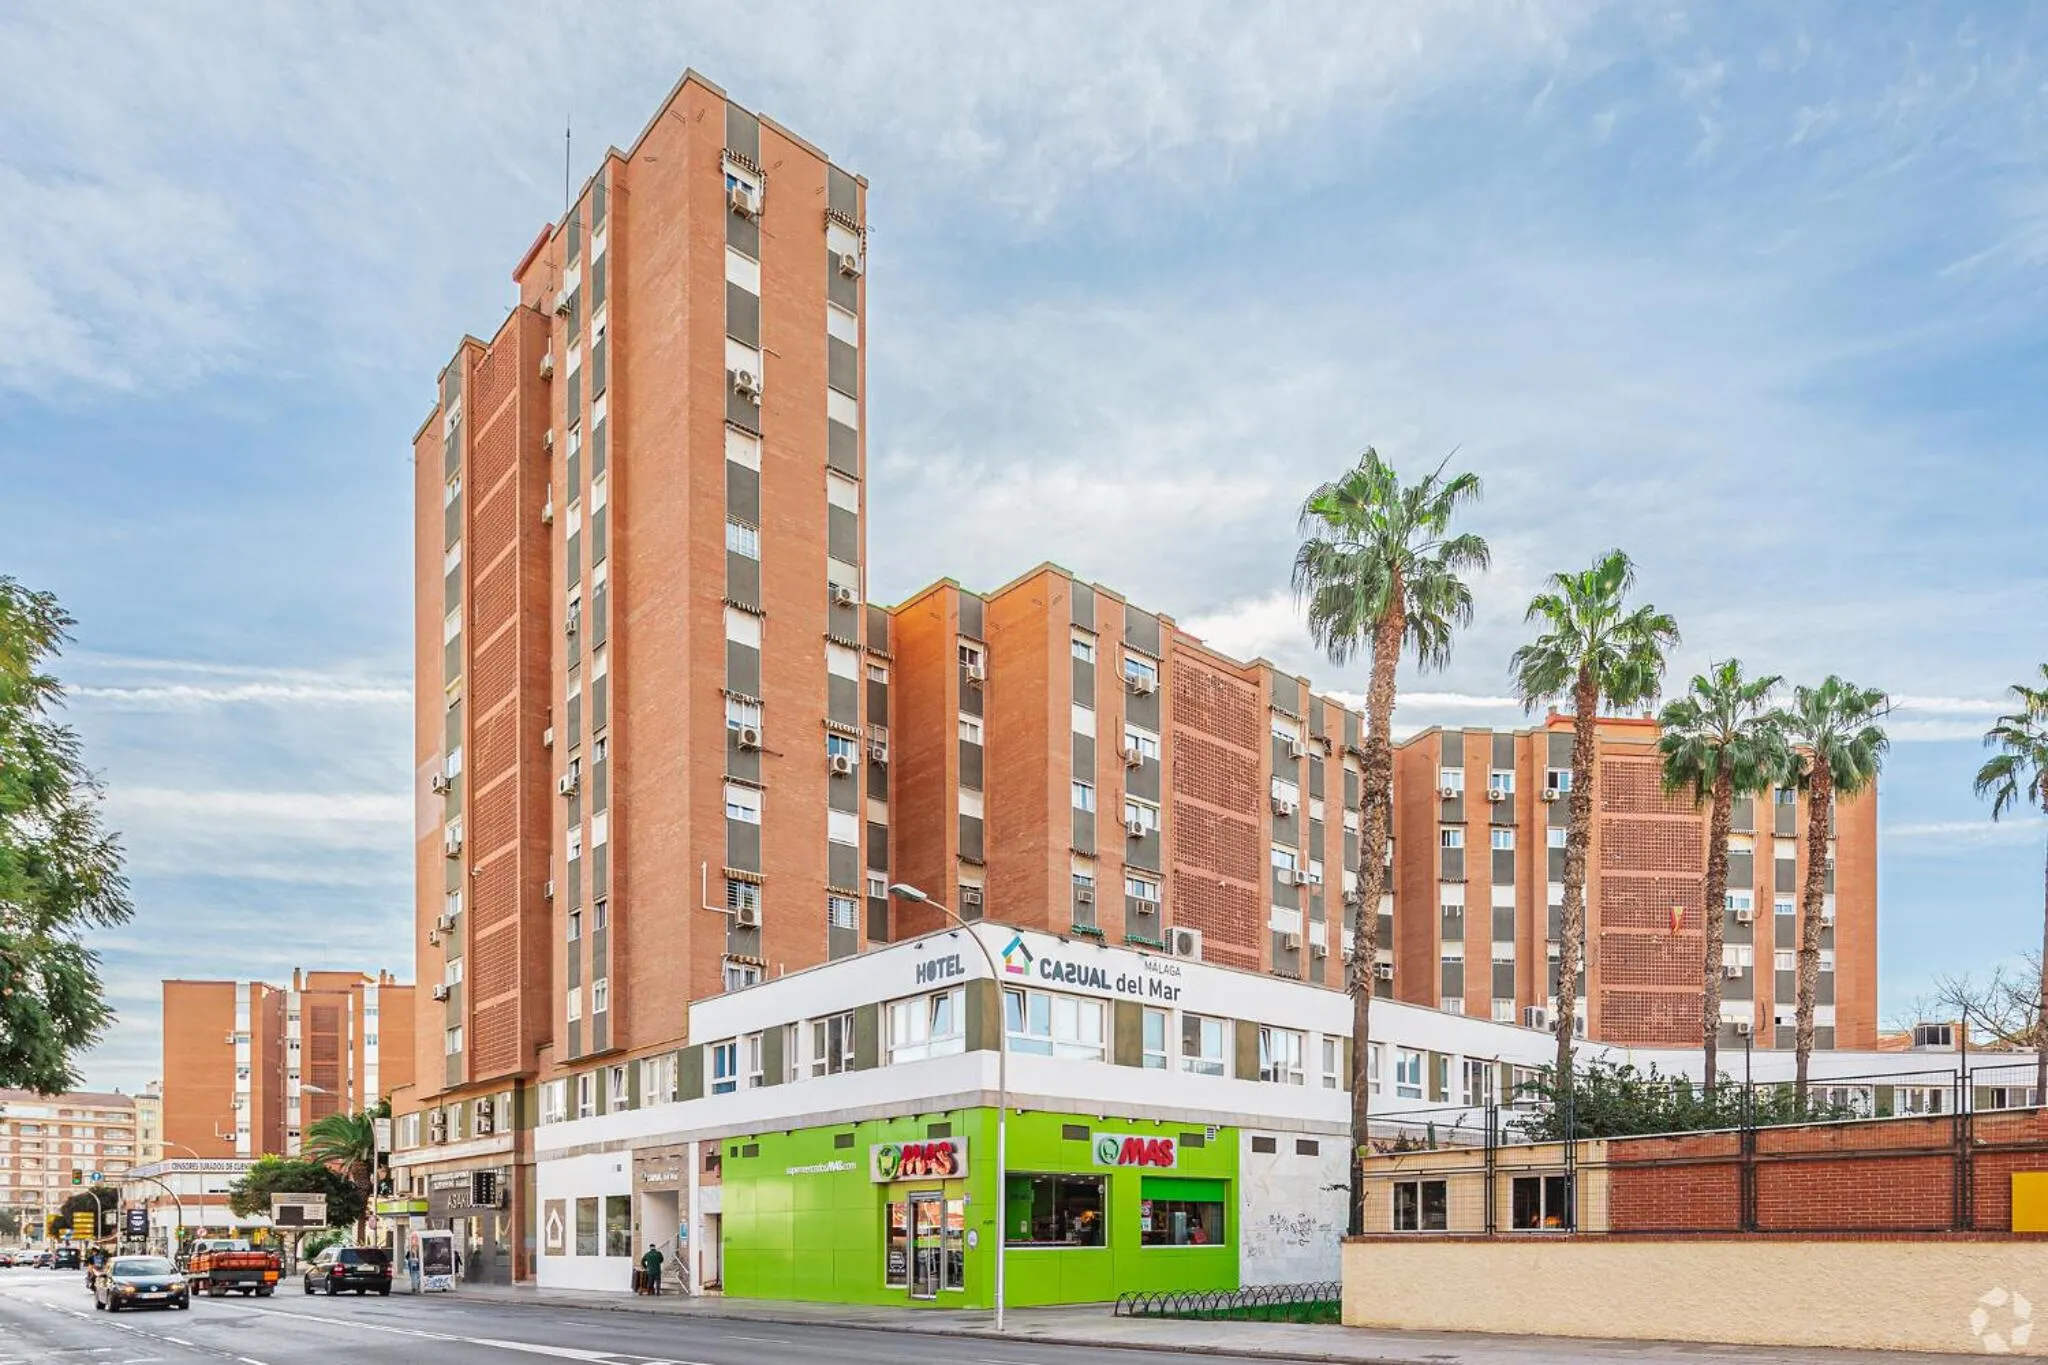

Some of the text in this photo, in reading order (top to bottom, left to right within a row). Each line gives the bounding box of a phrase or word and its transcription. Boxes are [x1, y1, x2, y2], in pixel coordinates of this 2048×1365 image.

[916, 953, 965, 985] HOTEL
[1116, 973, 1143, 995] del
[1150, 978, 1181, 1001] Mar
[896, 1141, 956, 1178] MAS
[1119, 1137, 1174, 1167] MAS
